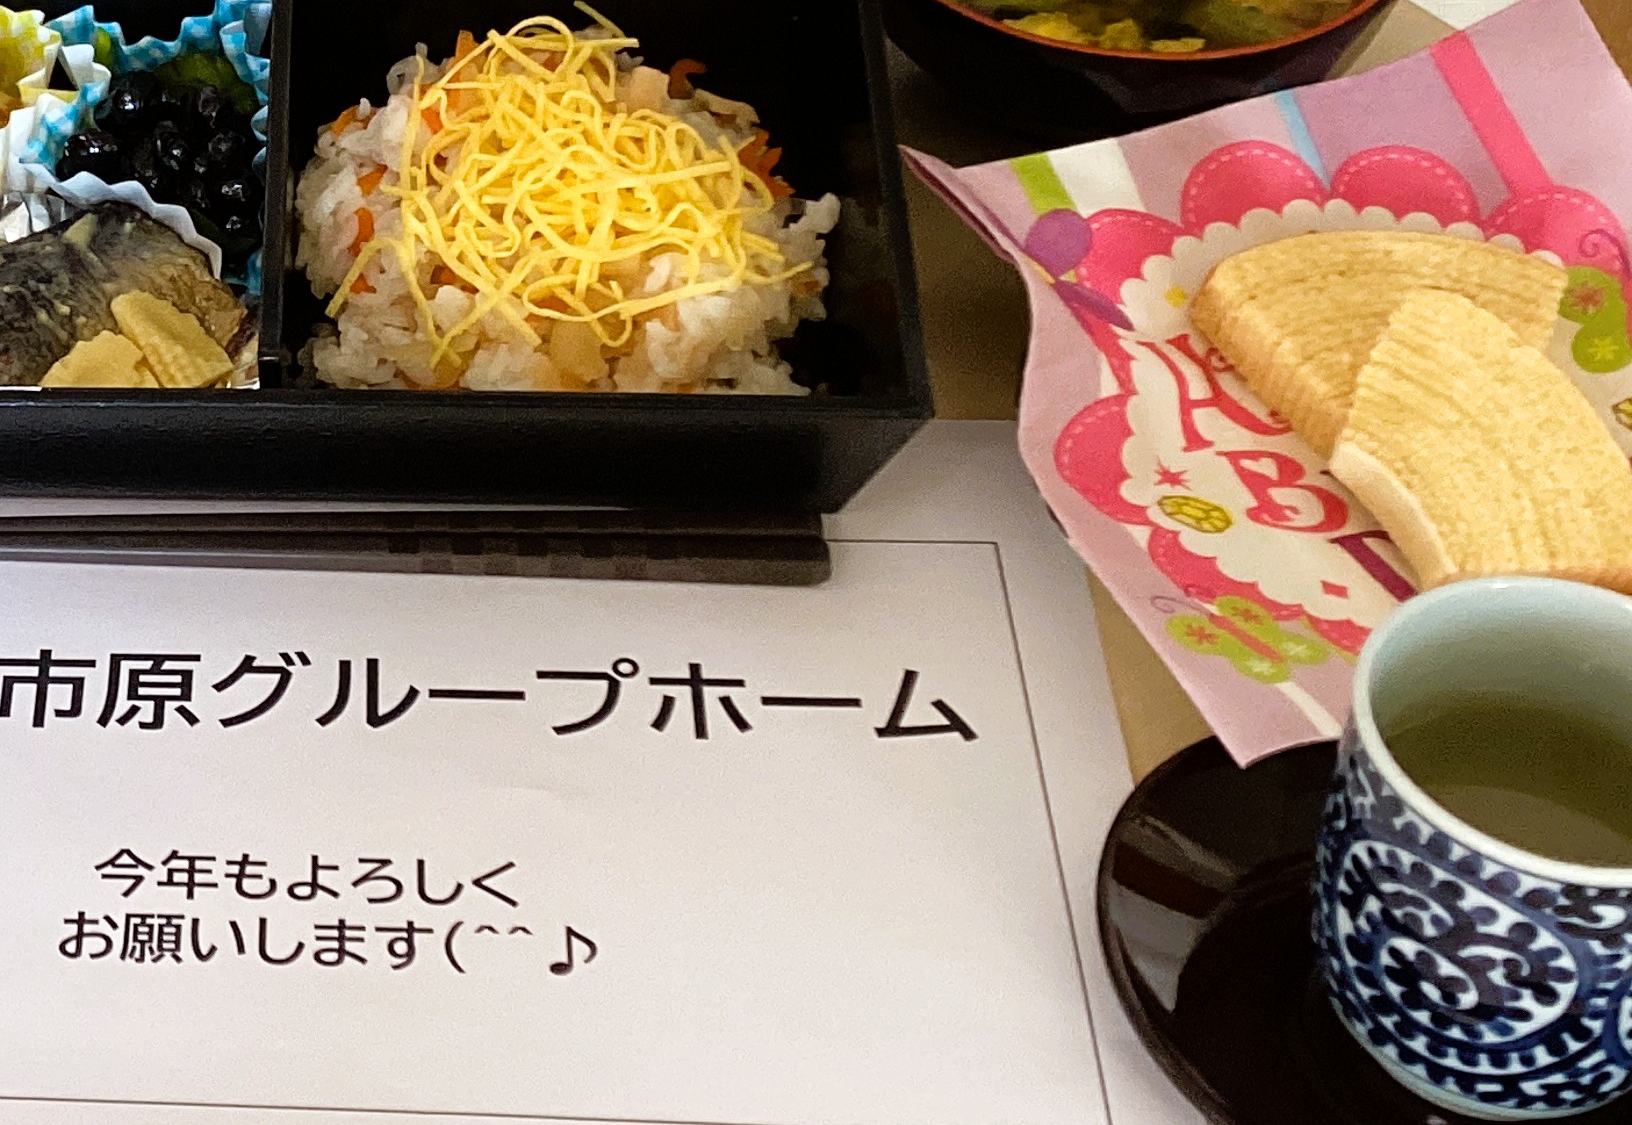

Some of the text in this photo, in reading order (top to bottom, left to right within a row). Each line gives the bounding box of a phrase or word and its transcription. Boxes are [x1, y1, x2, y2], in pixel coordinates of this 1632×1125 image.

[93, 848, 519, 908] 今年もよろしく
